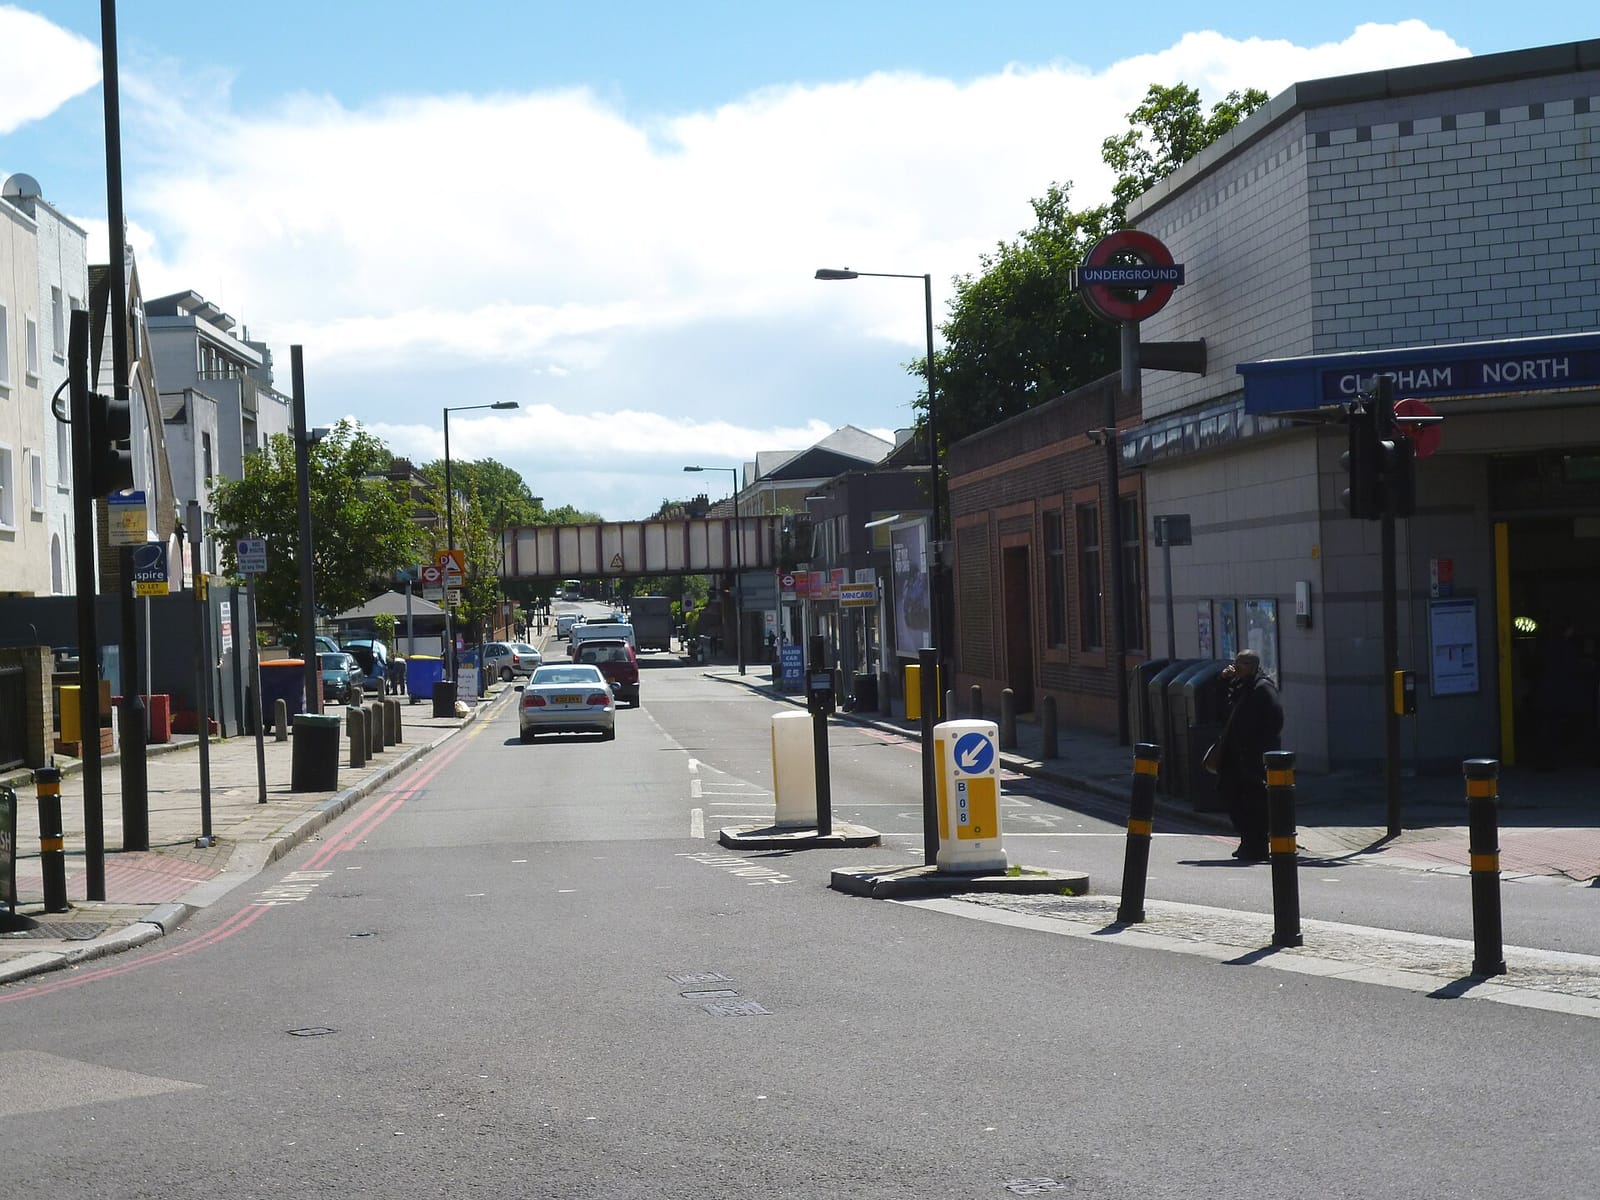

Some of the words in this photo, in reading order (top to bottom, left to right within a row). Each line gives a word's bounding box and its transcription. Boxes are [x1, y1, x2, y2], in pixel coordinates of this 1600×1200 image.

[1084, 269, 1178, 280] UNDERGROUND
[1482, 357, 1569, 383] NORTH
[841, 591, 873, 599] MINICABS
[785, 669, 800, 678] £5
